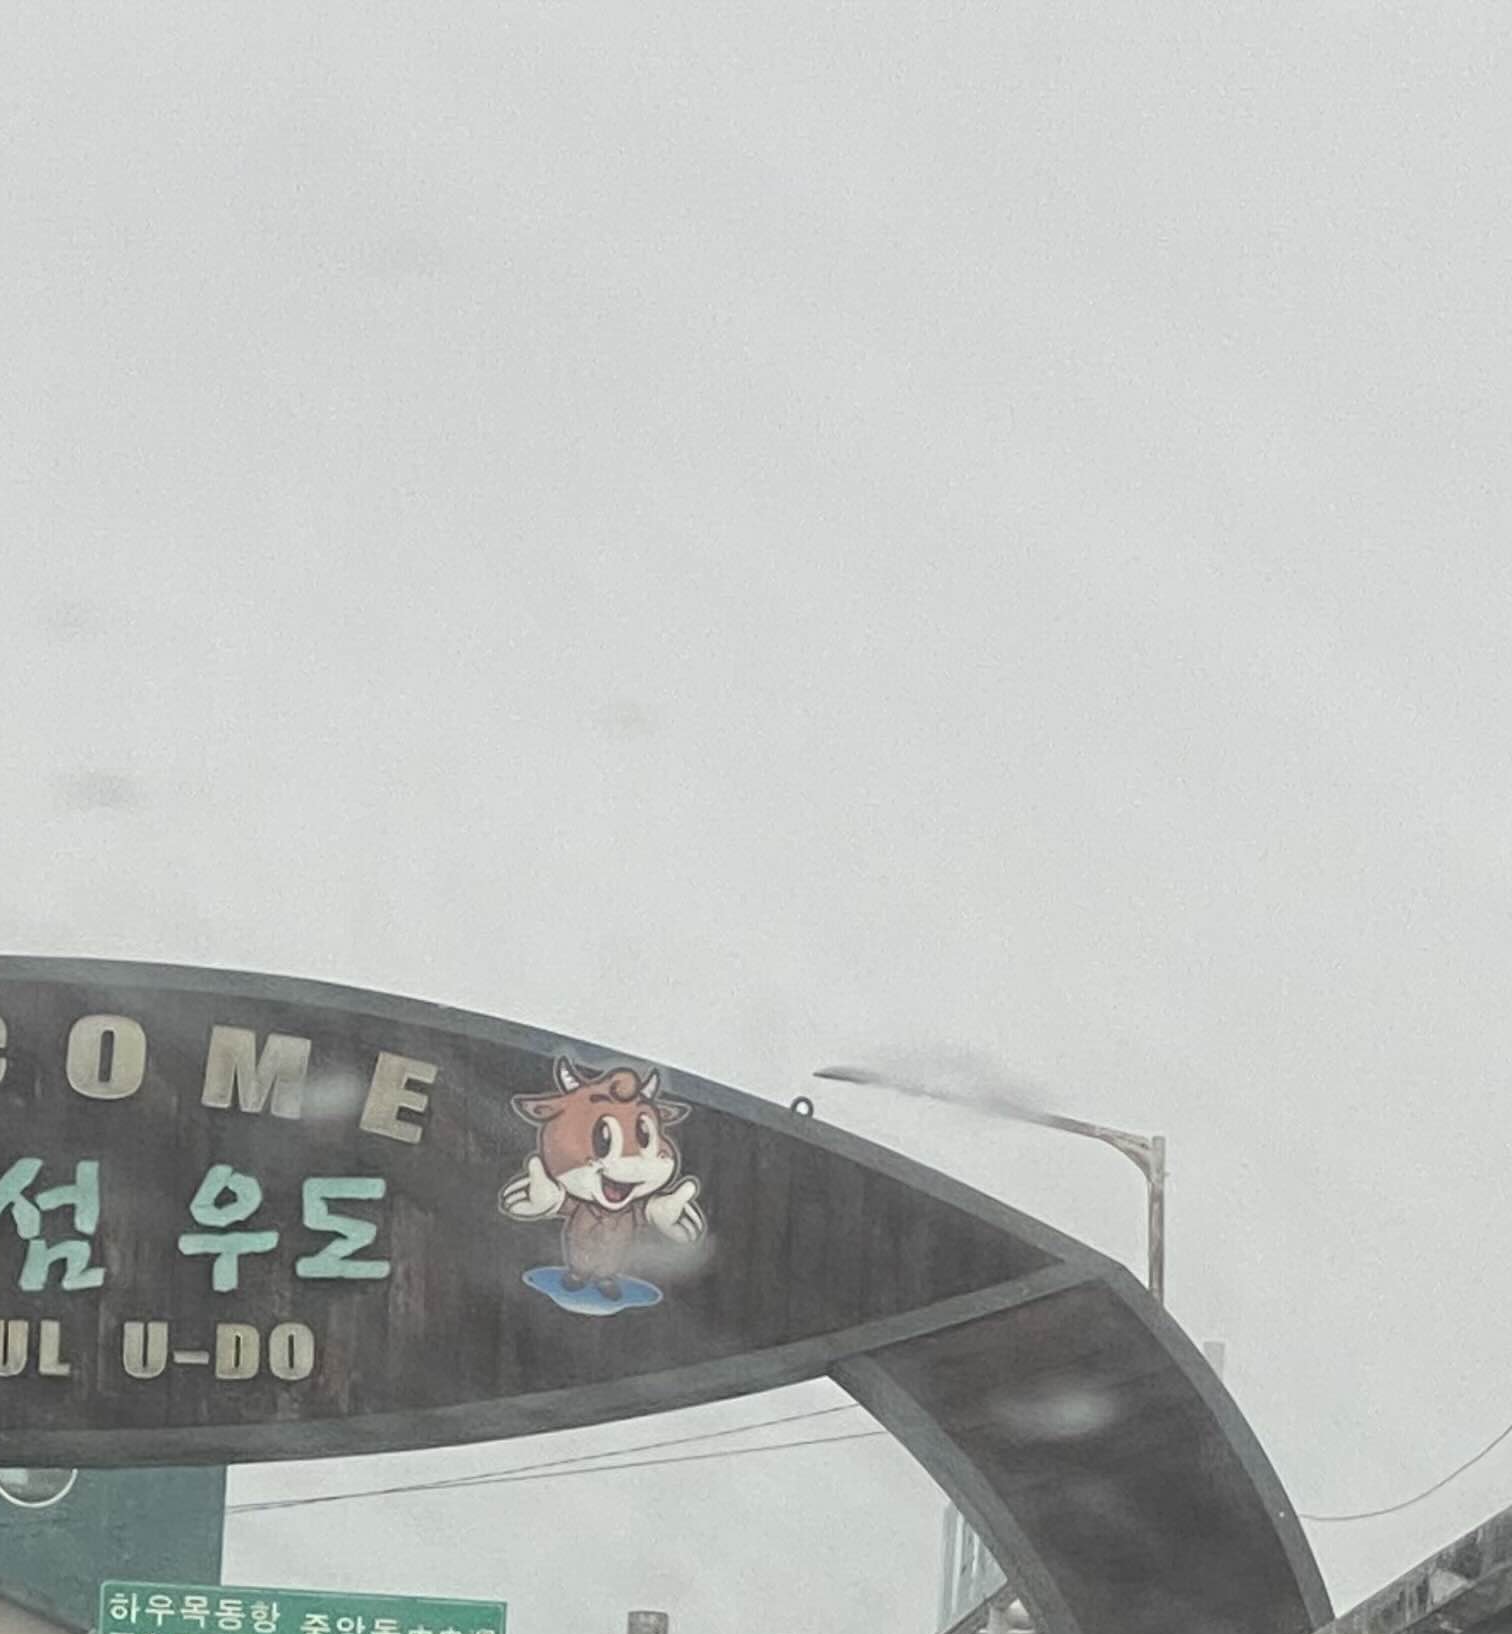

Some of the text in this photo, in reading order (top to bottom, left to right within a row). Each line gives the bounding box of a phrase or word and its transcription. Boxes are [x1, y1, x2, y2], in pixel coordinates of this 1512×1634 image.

[178, 1165, 393, 1291] 우도
[123, 1321, 316, 1382] U-DO
[109, 1592, 281, 1634] 하우목동항
